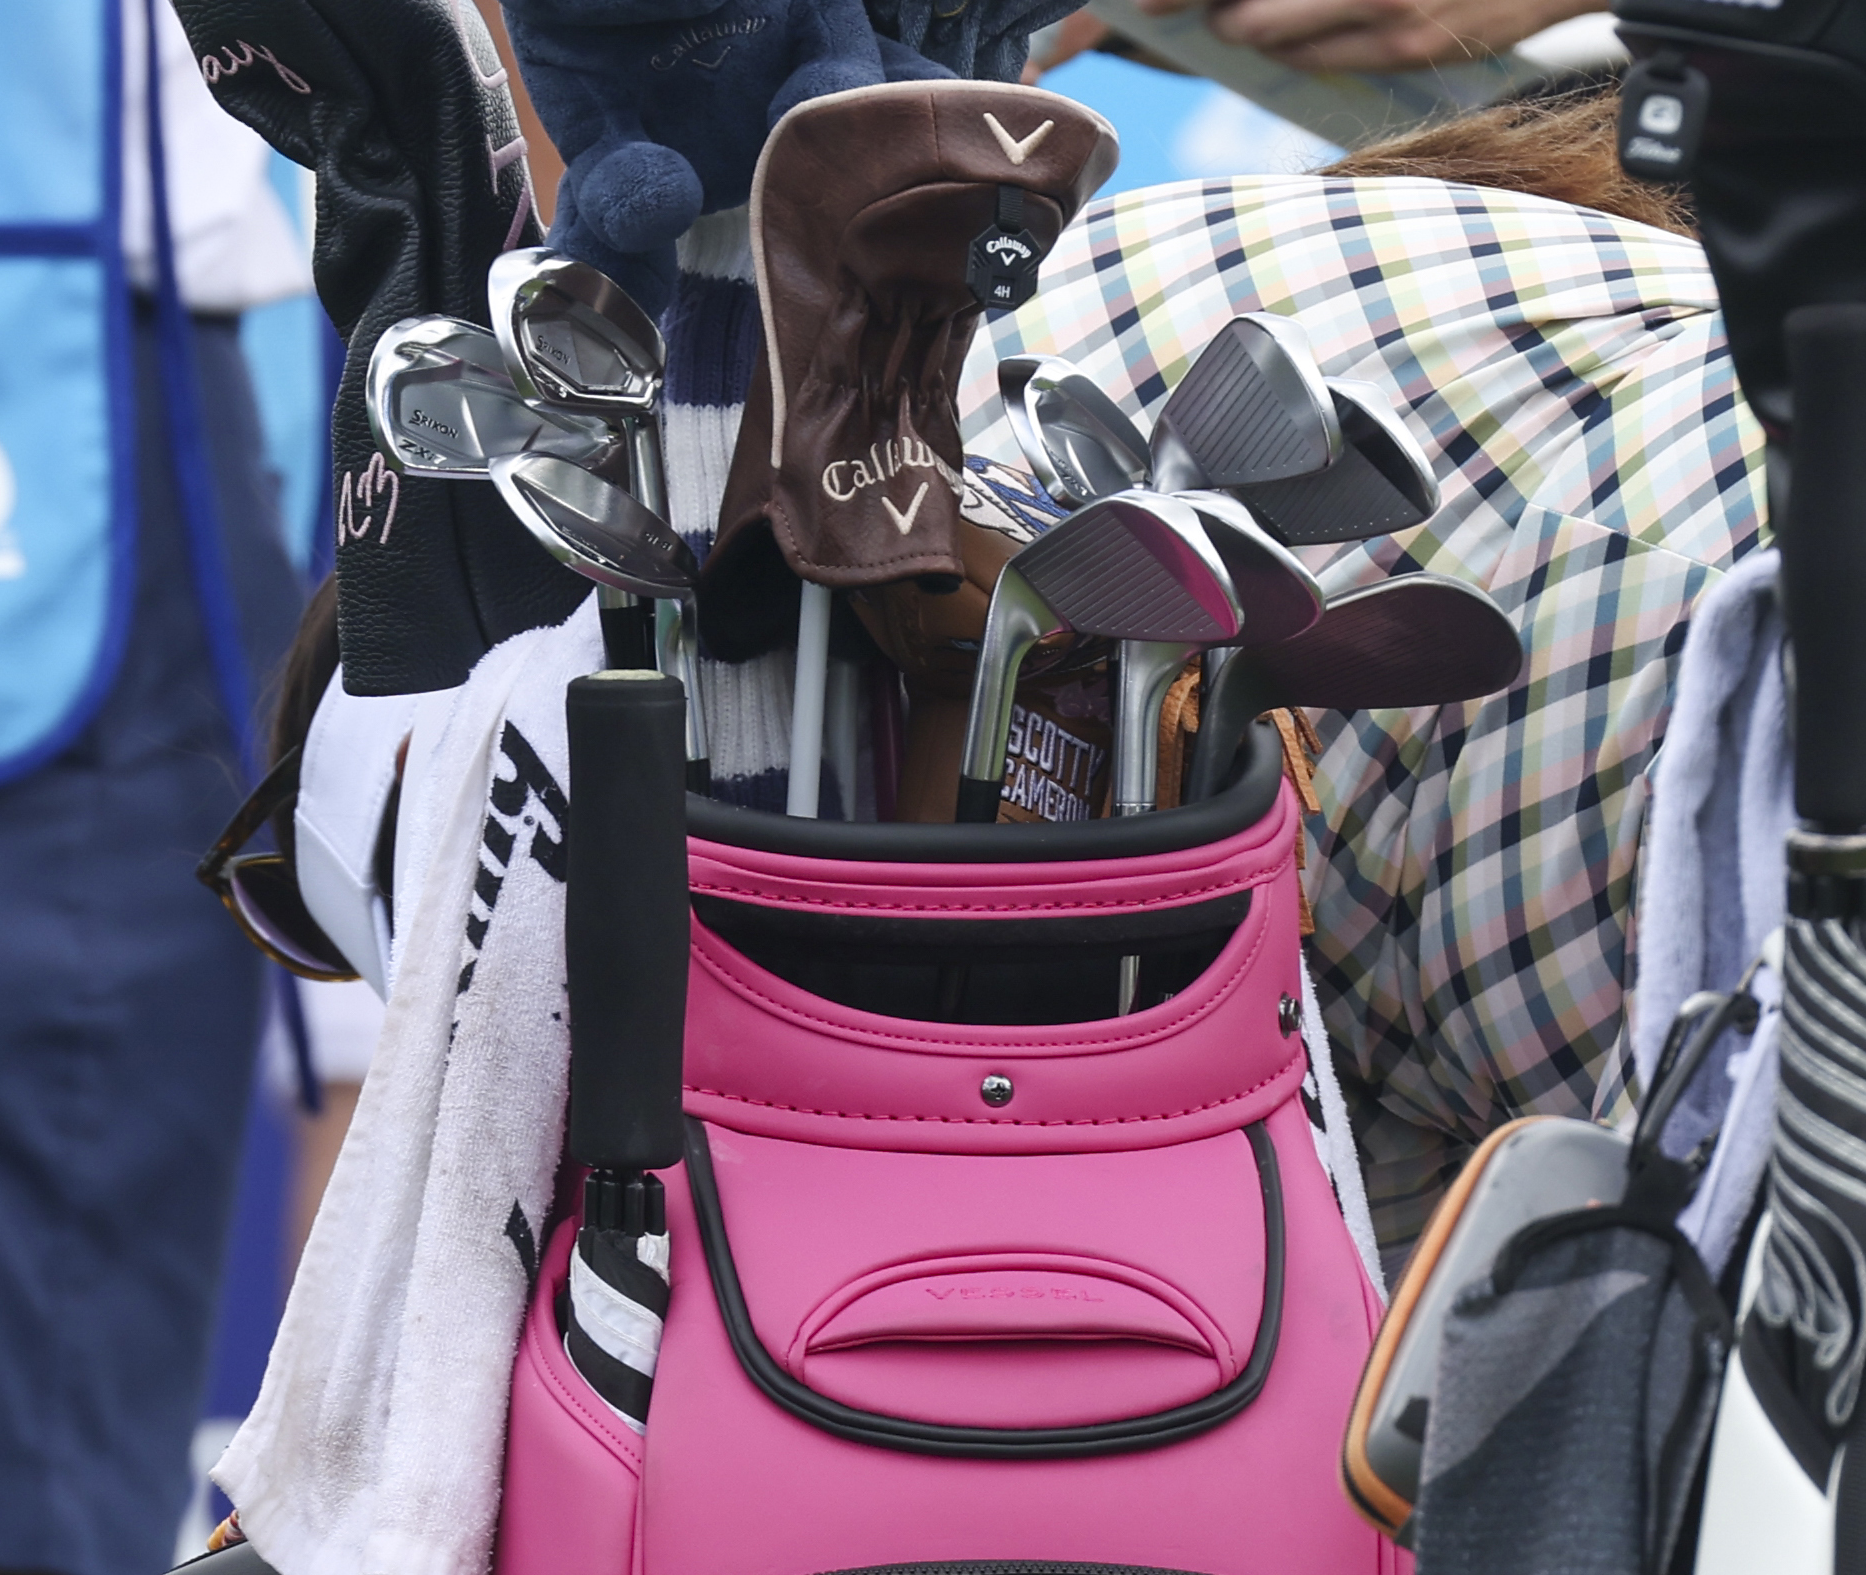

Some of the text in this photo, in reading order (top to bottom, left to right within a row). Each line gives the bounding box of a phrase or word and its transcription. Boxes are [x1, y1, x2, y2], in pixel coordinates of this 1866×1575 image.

[985, 235, 1032, 259] Callaway
[993, 284, 1011, 299] 4H
[1007, 703, 1107, 798] SCOTTY
[925, 1286, 1105, 1302] VESSEL
